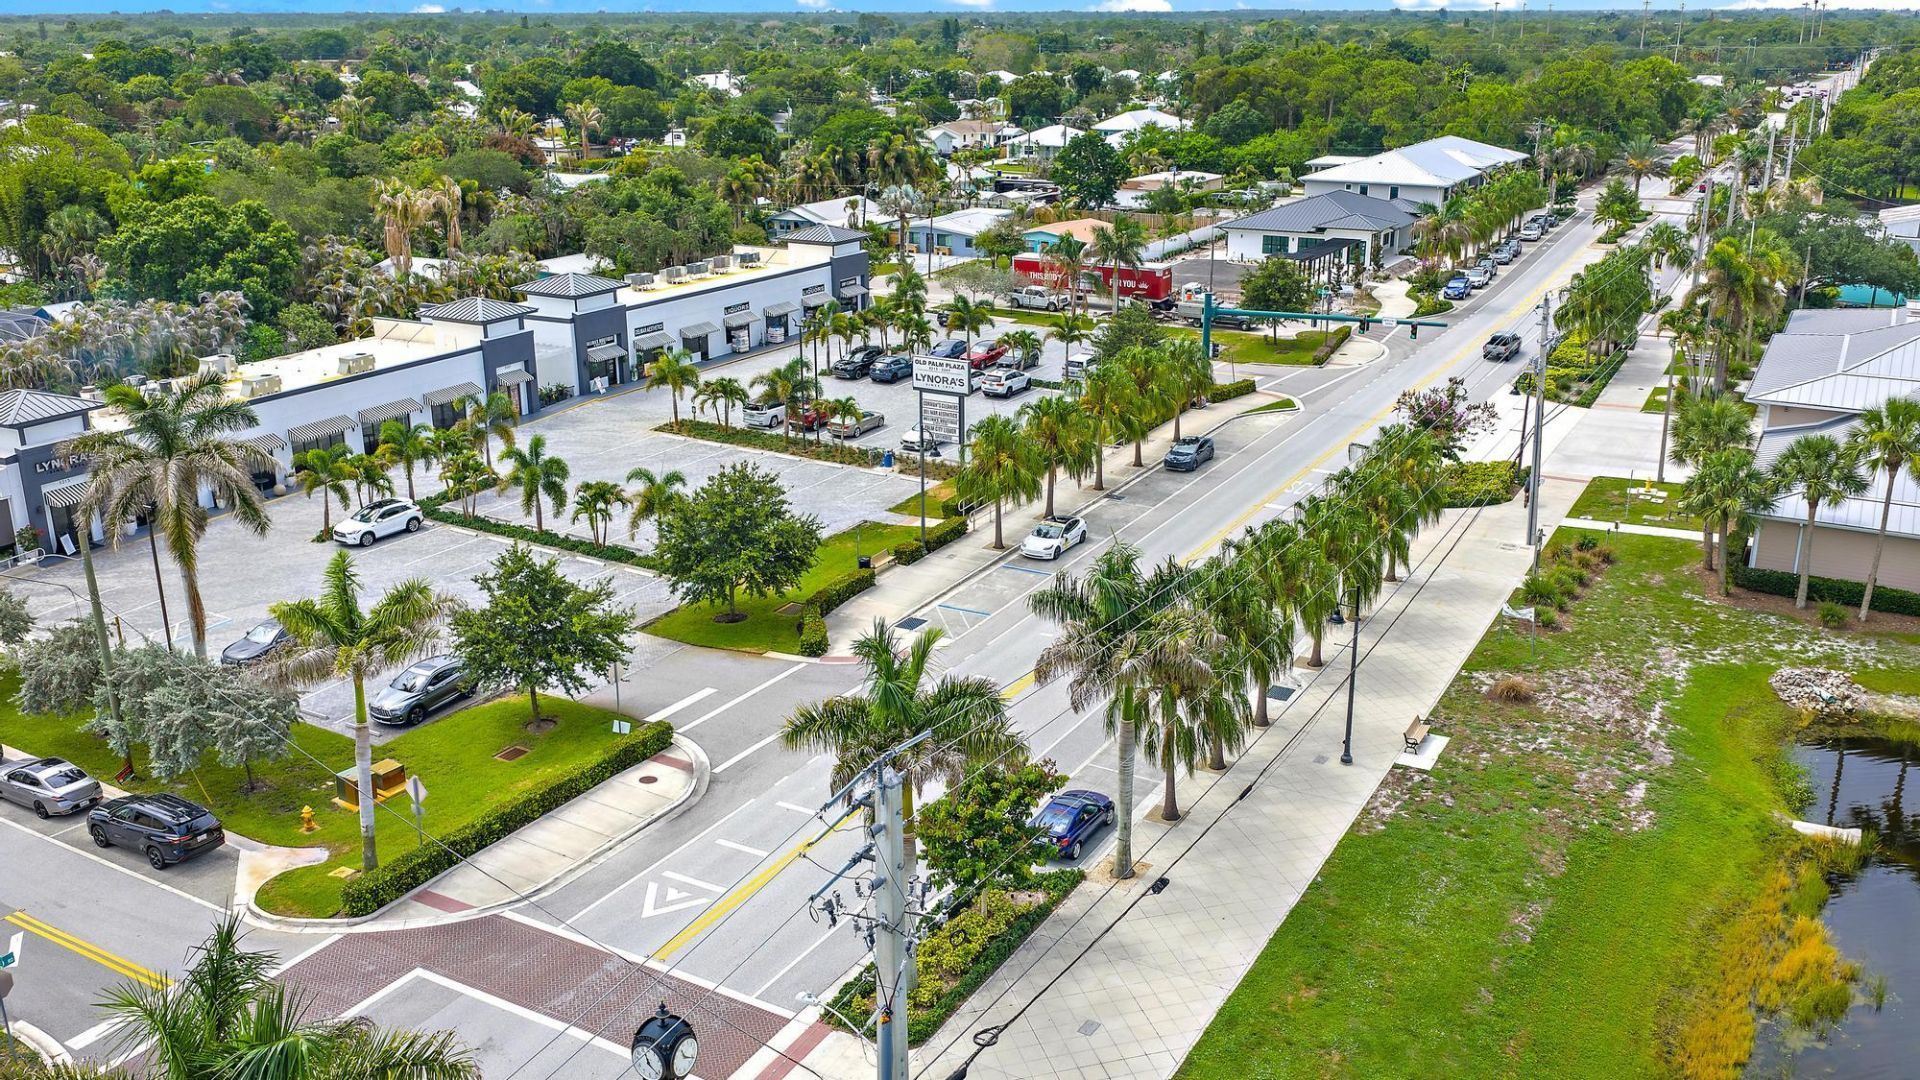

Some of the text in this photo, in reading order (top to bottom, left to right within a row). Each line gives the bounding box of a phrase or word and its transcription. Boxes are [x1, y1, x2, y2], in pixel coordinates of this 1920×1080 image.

[1029, 271, 1043, 280] THIS
[1109, 278, 1122, 287] FR
[1123, 279, 1136, 288] YOU
[724, 303, 749, 315] LIQUORS
[928, 360, 944, 368] PALM
[945, 362, 965, 370] PLAZA
[915, 373, 965, 387] LYNORA'S
[36, 453, 97, 473] LYNRA'S
